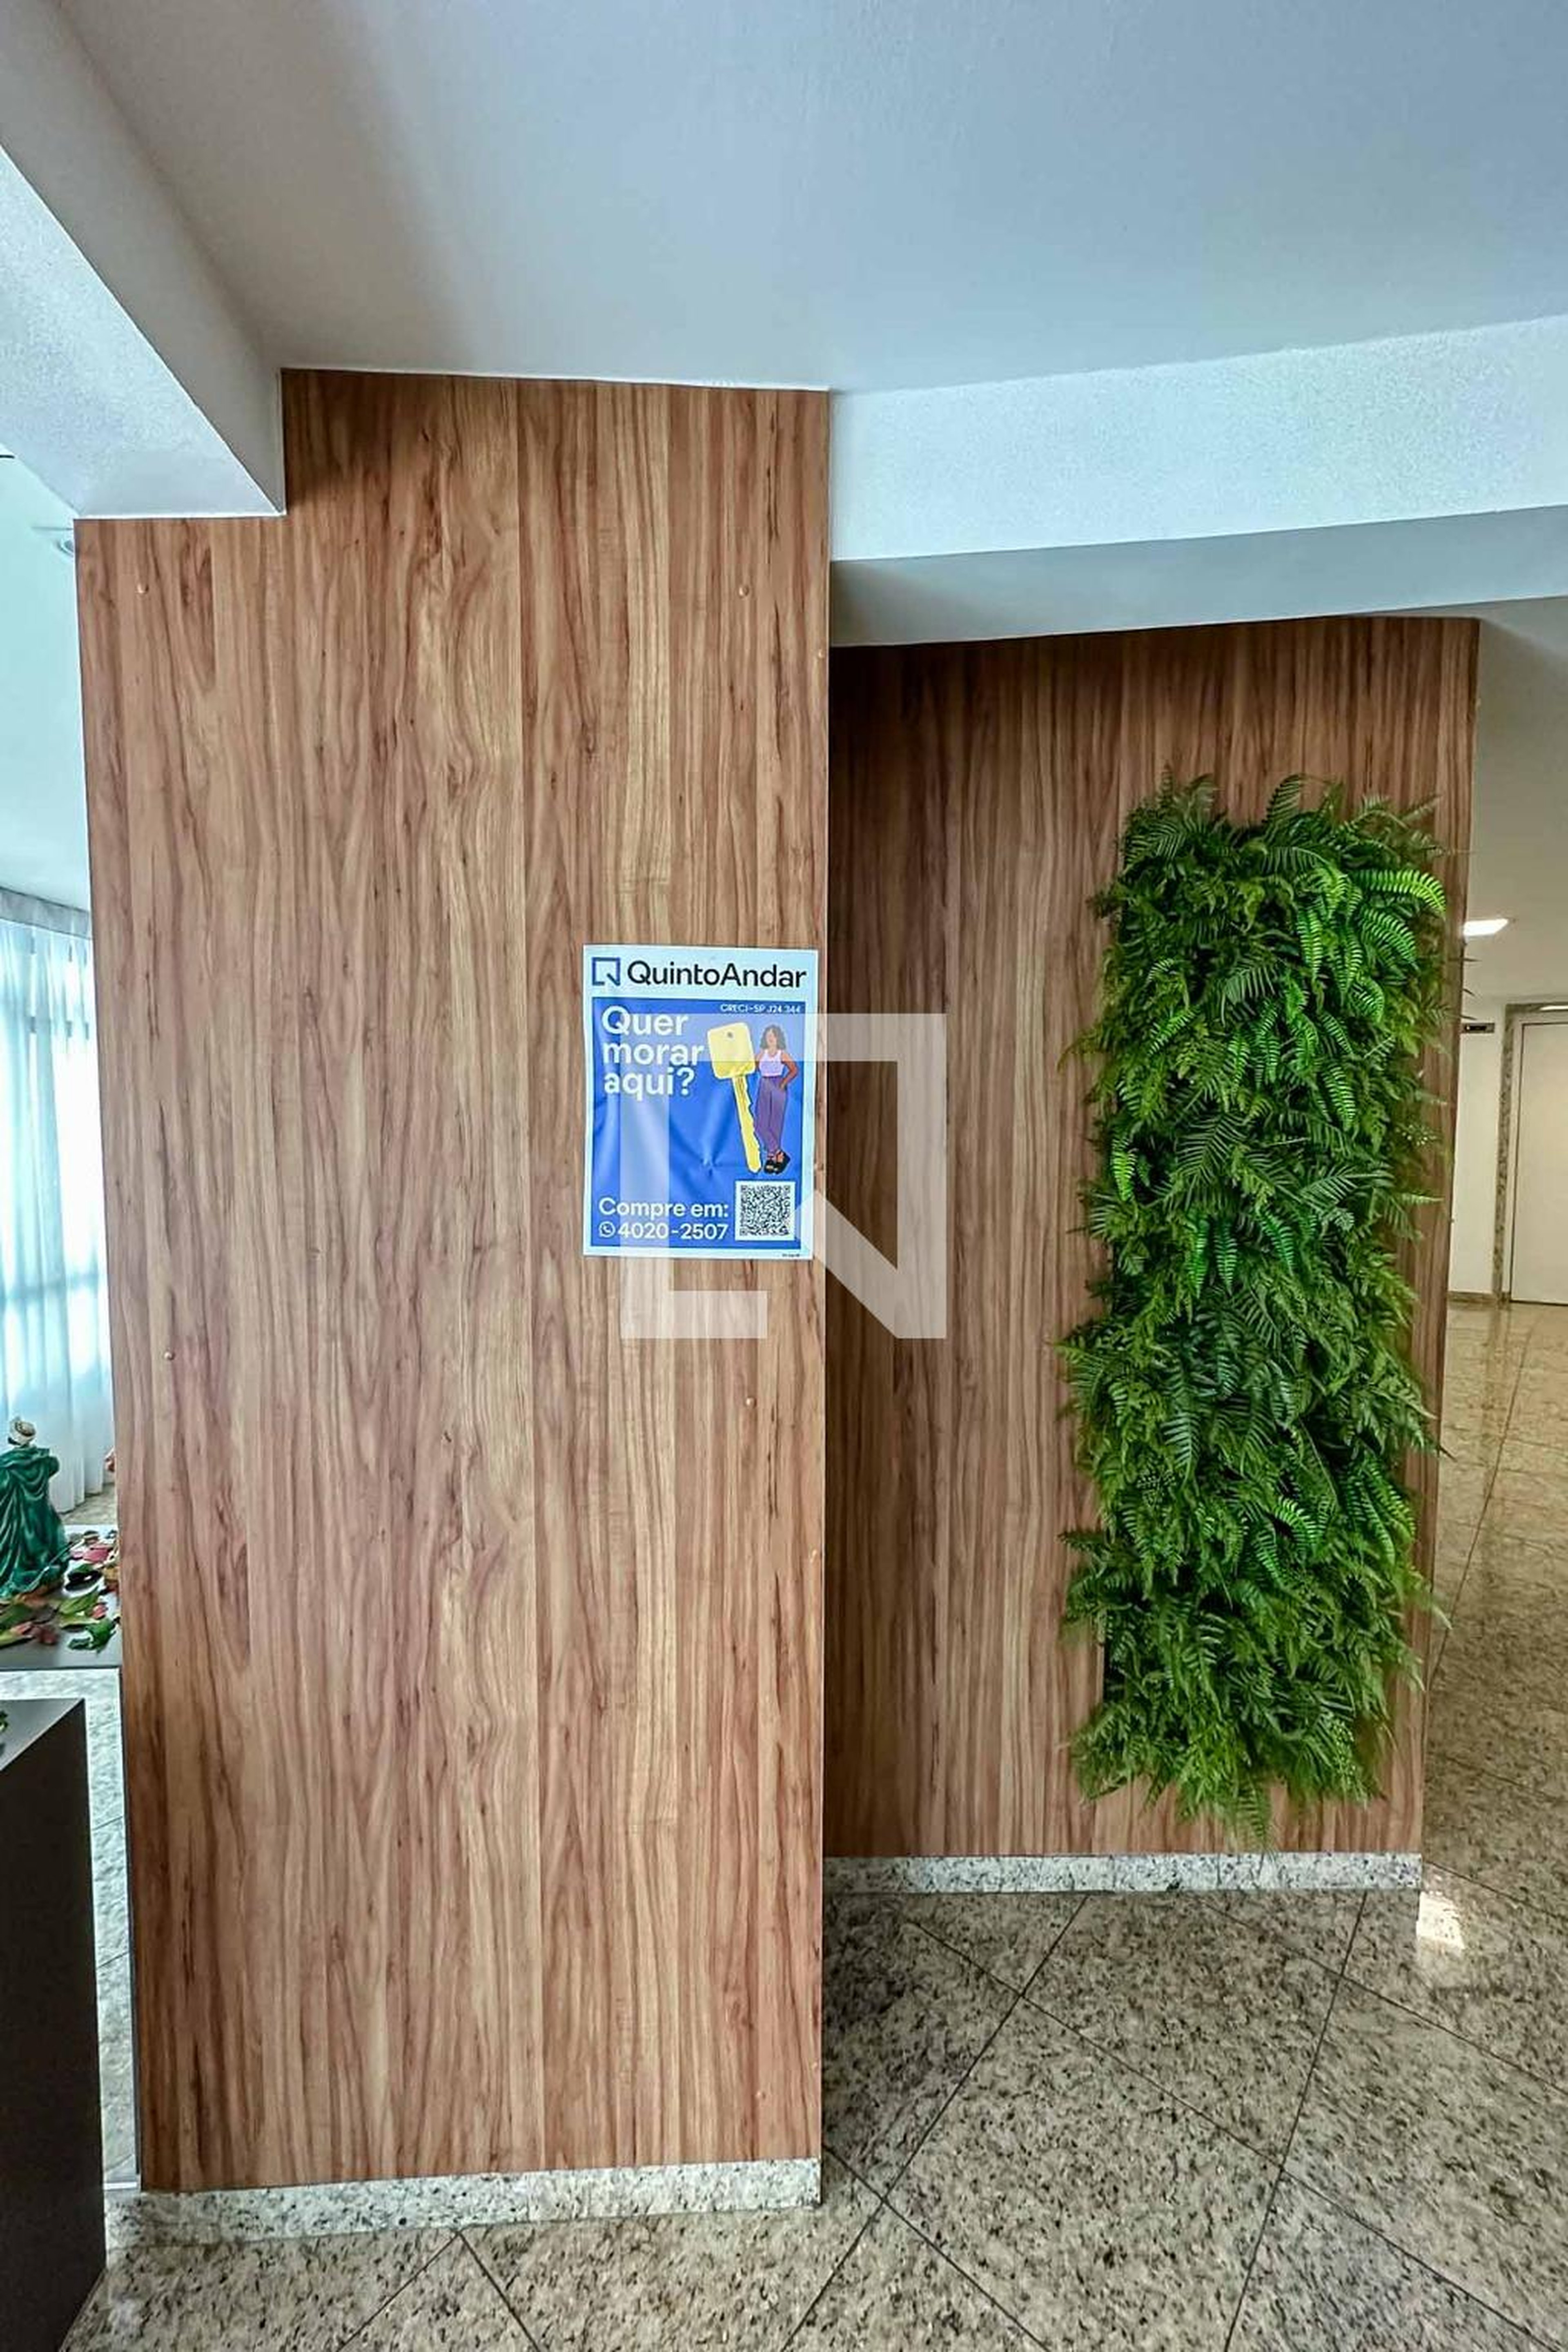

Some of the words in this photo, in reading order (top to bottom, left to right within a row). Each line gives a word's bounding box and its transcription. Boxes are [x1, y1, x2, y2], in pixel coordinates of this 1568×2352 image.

[627, 960, 806, 987] QuintoAndar
[602, 1006, 688, 1036] Quer
[604, 1042, 704, 1066] morar
[604, 1067, 695, 1100] aqui?
[599, 1197, 685, 1220] Compre
[690, 1203, 728, 1217] em:
[618, 1223, 728, 1240] 4020-2507
